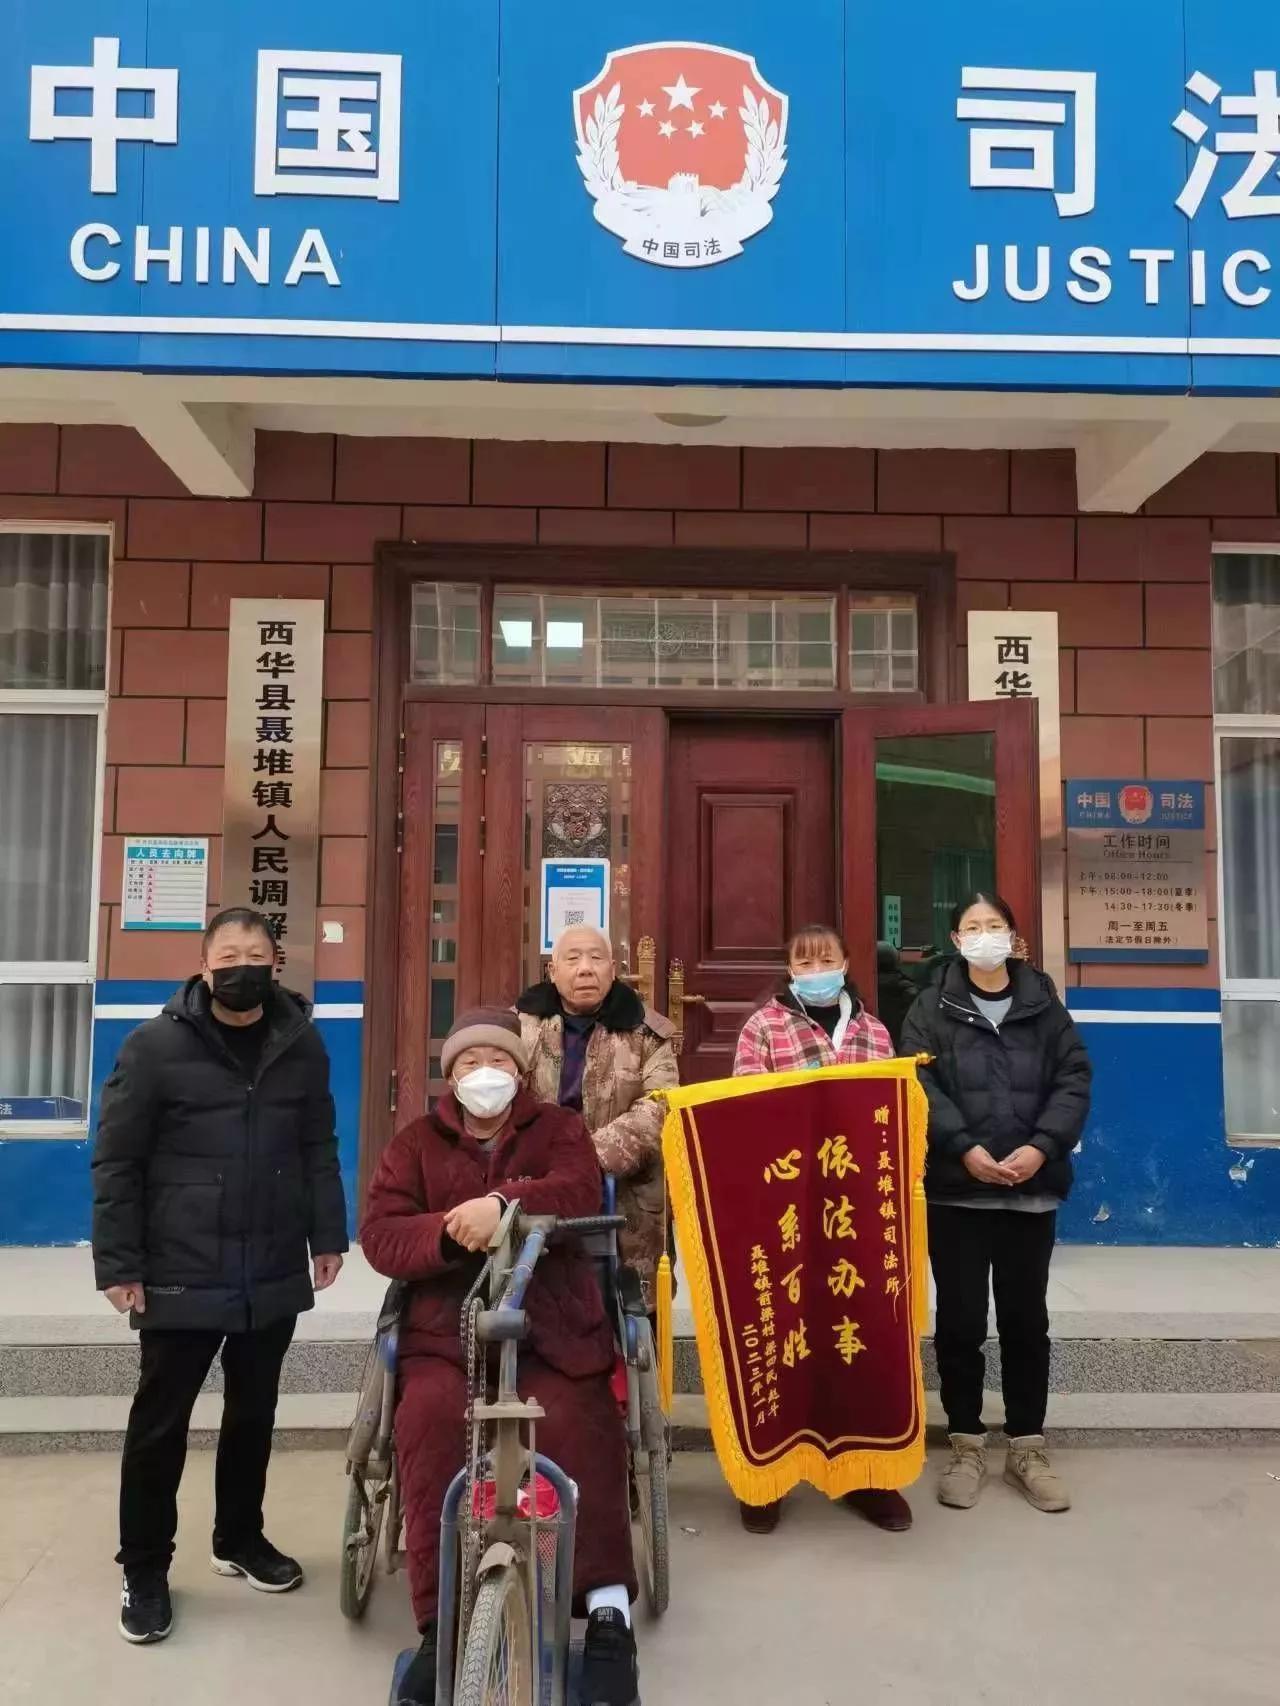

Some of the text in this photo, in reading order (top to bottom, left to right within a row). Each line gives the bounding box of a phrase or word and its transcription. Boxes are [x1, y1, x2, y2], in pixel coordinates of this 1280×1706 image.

[29, 36, 1280, 220] 中国 司法
[70, 223, 1272, 306] CHINA JUSTIC
[642, 237, 722, 259] 中国司法
[1077, 792, 1193, 809] 中国 司法
[1103, 834, 1170, 849] 工作时间
[1107, 921, 1169, 932] 周一至周五
[763, 1149, 812, 1369] 心系百姓
[817, 1135, 868, 1366] 依法办事
